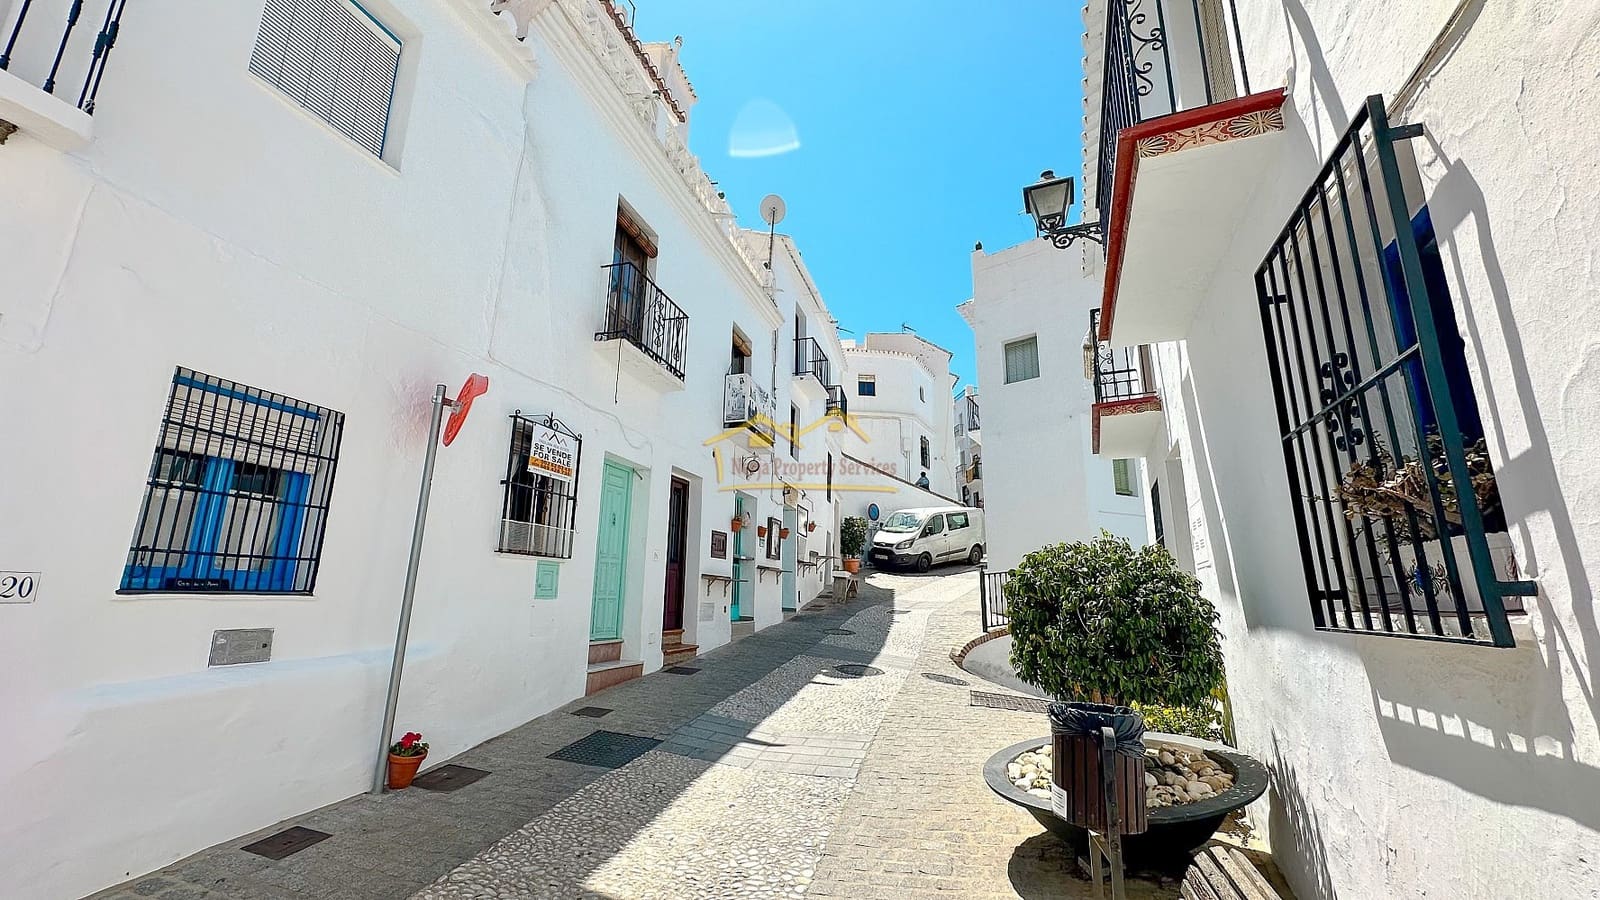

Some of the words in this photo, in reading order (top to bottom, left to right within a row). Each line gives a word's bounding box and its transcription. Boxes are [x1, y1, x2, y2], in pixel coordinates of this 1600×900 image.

[534, 443, 544, 451] SE
[547, 447, 572, 460] VENDE
[534, 450, 549, 460] FOR
[552, 456, 572, 467] SALE
[0, 575, 34, 599] 20
